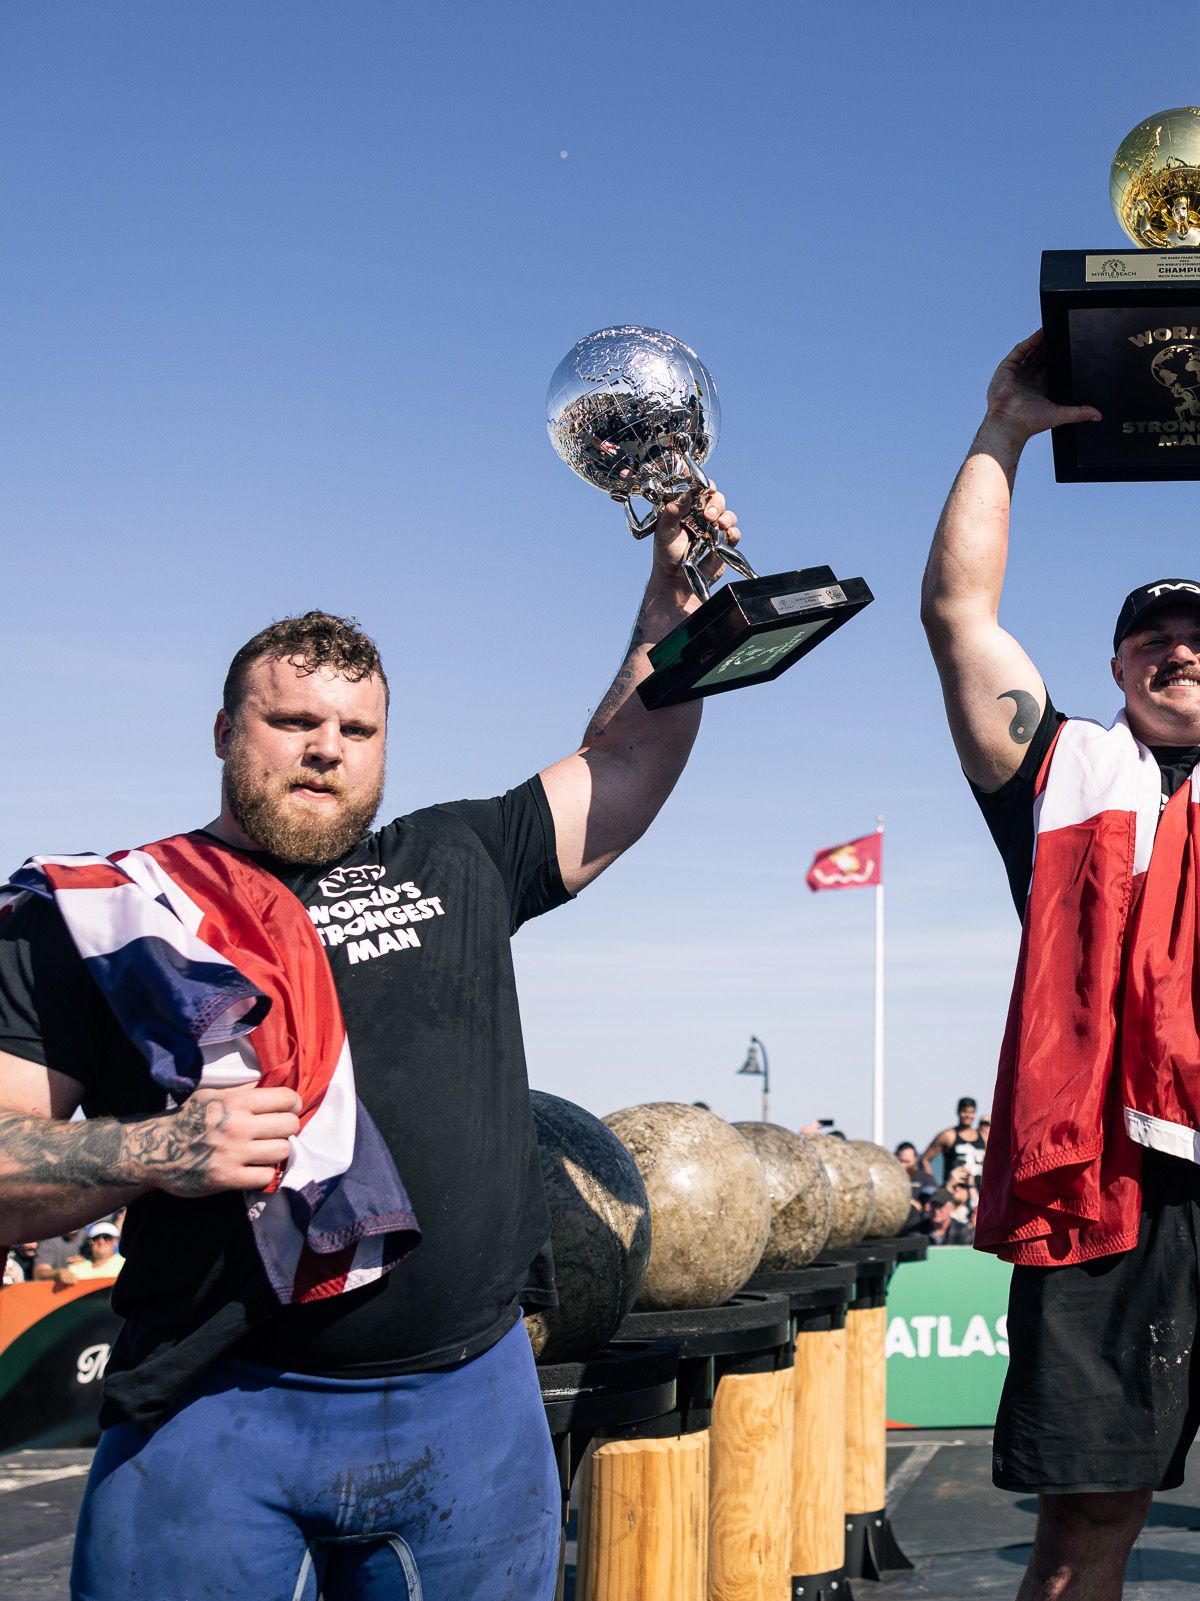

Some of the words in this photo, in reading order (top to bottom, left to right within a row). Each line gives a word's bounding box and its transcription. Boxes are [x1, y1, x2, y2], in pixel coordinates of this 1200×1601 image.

[305, 881, 422, 925] WORLD'S
[316, 896, 446, 947] TRONGEST
[346, 927, 422, 965] MAN
